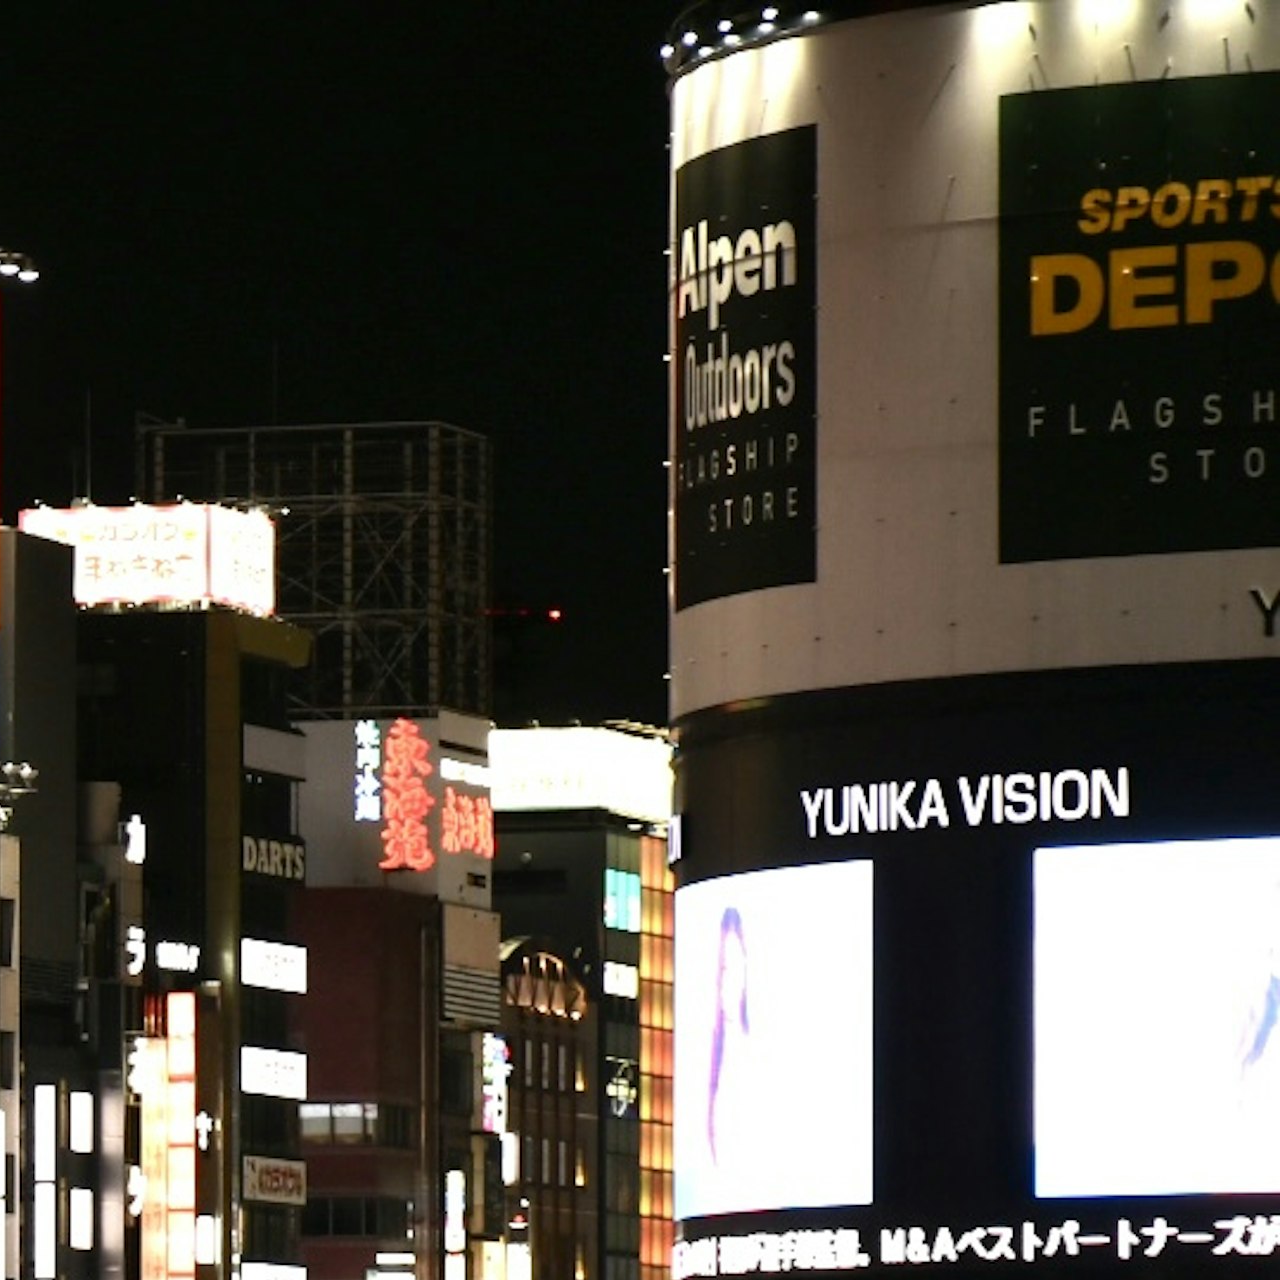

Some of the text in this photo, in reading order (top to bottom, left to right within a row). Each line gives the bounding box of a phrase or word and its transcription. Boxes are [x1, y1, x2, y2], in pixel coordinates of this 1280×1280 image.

[1077, 175, 1280, 235] SPORT
[678, 218, 797, 330] Alpen
[1029, 240, 1280, 336] DEP
[685, 329, 796, 433] Outdoors
[1028, 391, 1275, 438] FLAGSH
[679, 432, 799, 489] FLAGSHIP
[1148, 446, 1266, 484] STO
[708, 487, 798, 532] STORE
[800, 767, 1130, 838] YUNIKA VISION
[243, 835, 305, 880] DARTS
